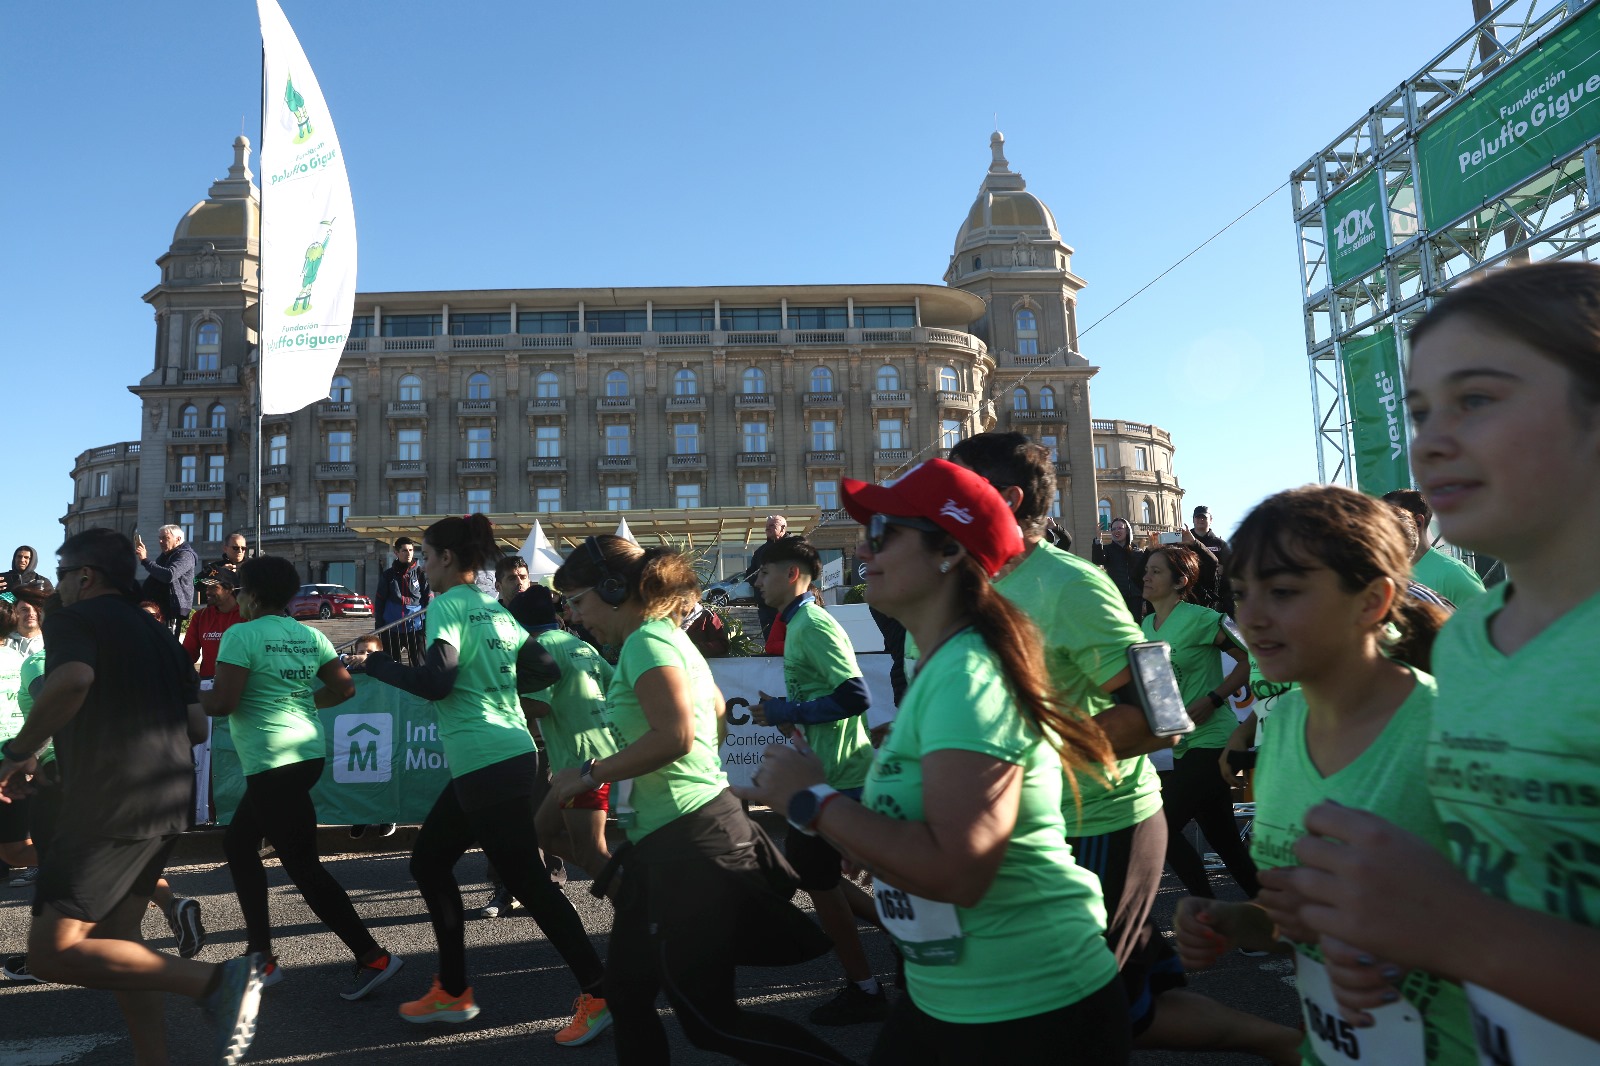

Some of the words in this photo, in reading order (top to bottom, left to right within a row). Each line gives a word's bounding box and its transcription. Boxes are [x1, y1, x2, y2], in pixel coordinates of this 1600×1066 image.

[1500, 69, 1566, 120] Fundación
[1458, 120, 1528, 174] Peluffo
[1333, 202, 1376, 250] 10K
[281, 322, 319, 333] Fundación
[265, 643, 293, 654] Peluffo
